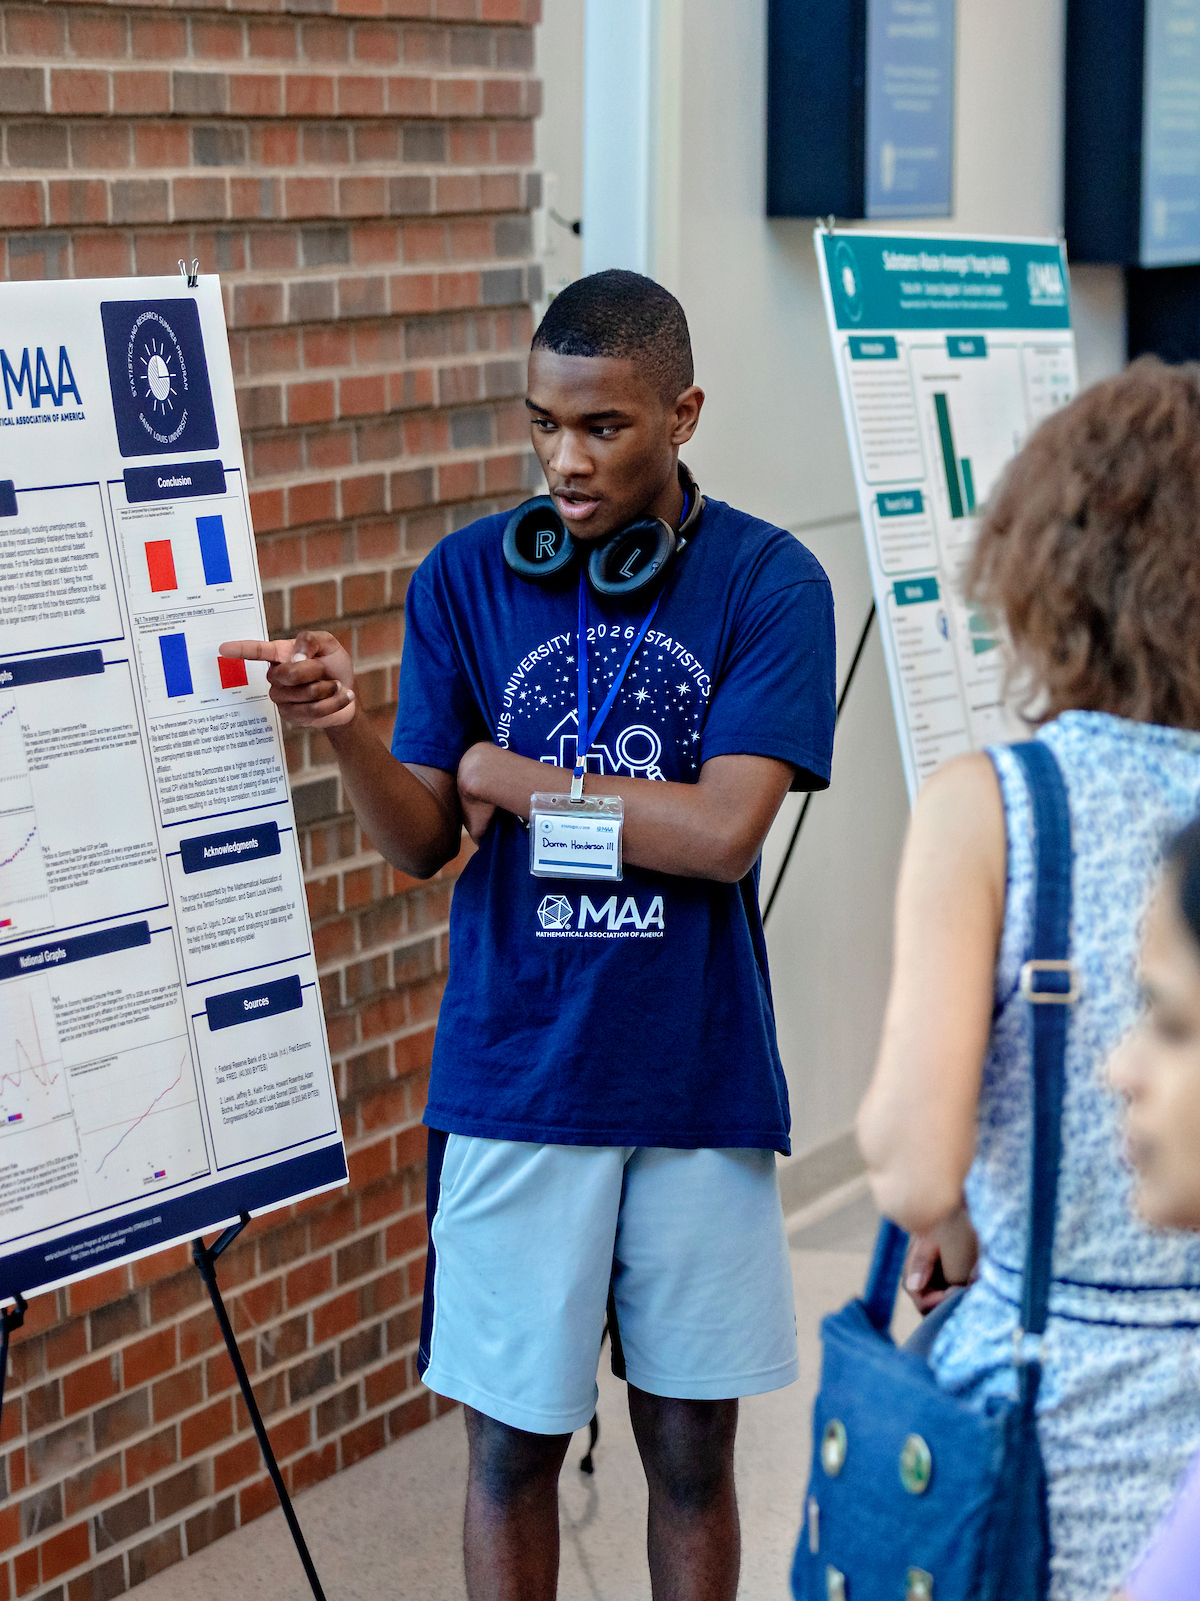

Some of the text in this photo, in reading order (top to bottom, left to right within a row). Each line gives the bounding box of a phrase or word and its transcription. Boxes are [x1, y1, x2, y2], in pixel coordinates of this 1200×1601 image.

[128, 342, 137, 398] STATISTICS
[136, 311, 158, 327] RESEARCH
[159, 316, 178, 344] SUMMER
[176, 345, 189, 390] PROGRAM
[0, 346, 82, 410] MAA
[16, 414, 51, 425] ASSOCIATION
[52, 413, 59, 422] OF
[60, 411, 86, 421] AMERICA
[139, 408, 188, 444] SAINT LOUIS UNIVERSITY
[158, 475, 192, 488] Conclusion
[536, 530, 555, 558] R
[619, 548, 641, 578] L
[497, 624, 712, 750] OUIS UNIVERSITY 2026 STATISTICS
[204, 838, 259, 858] Acknowledgments
[543, 837, 567, 848] Darren
[578, 895, 665, 930] MAA
[20, 948, 67, 968] National Graphs
[244, 997, 269, 1011] Sources
